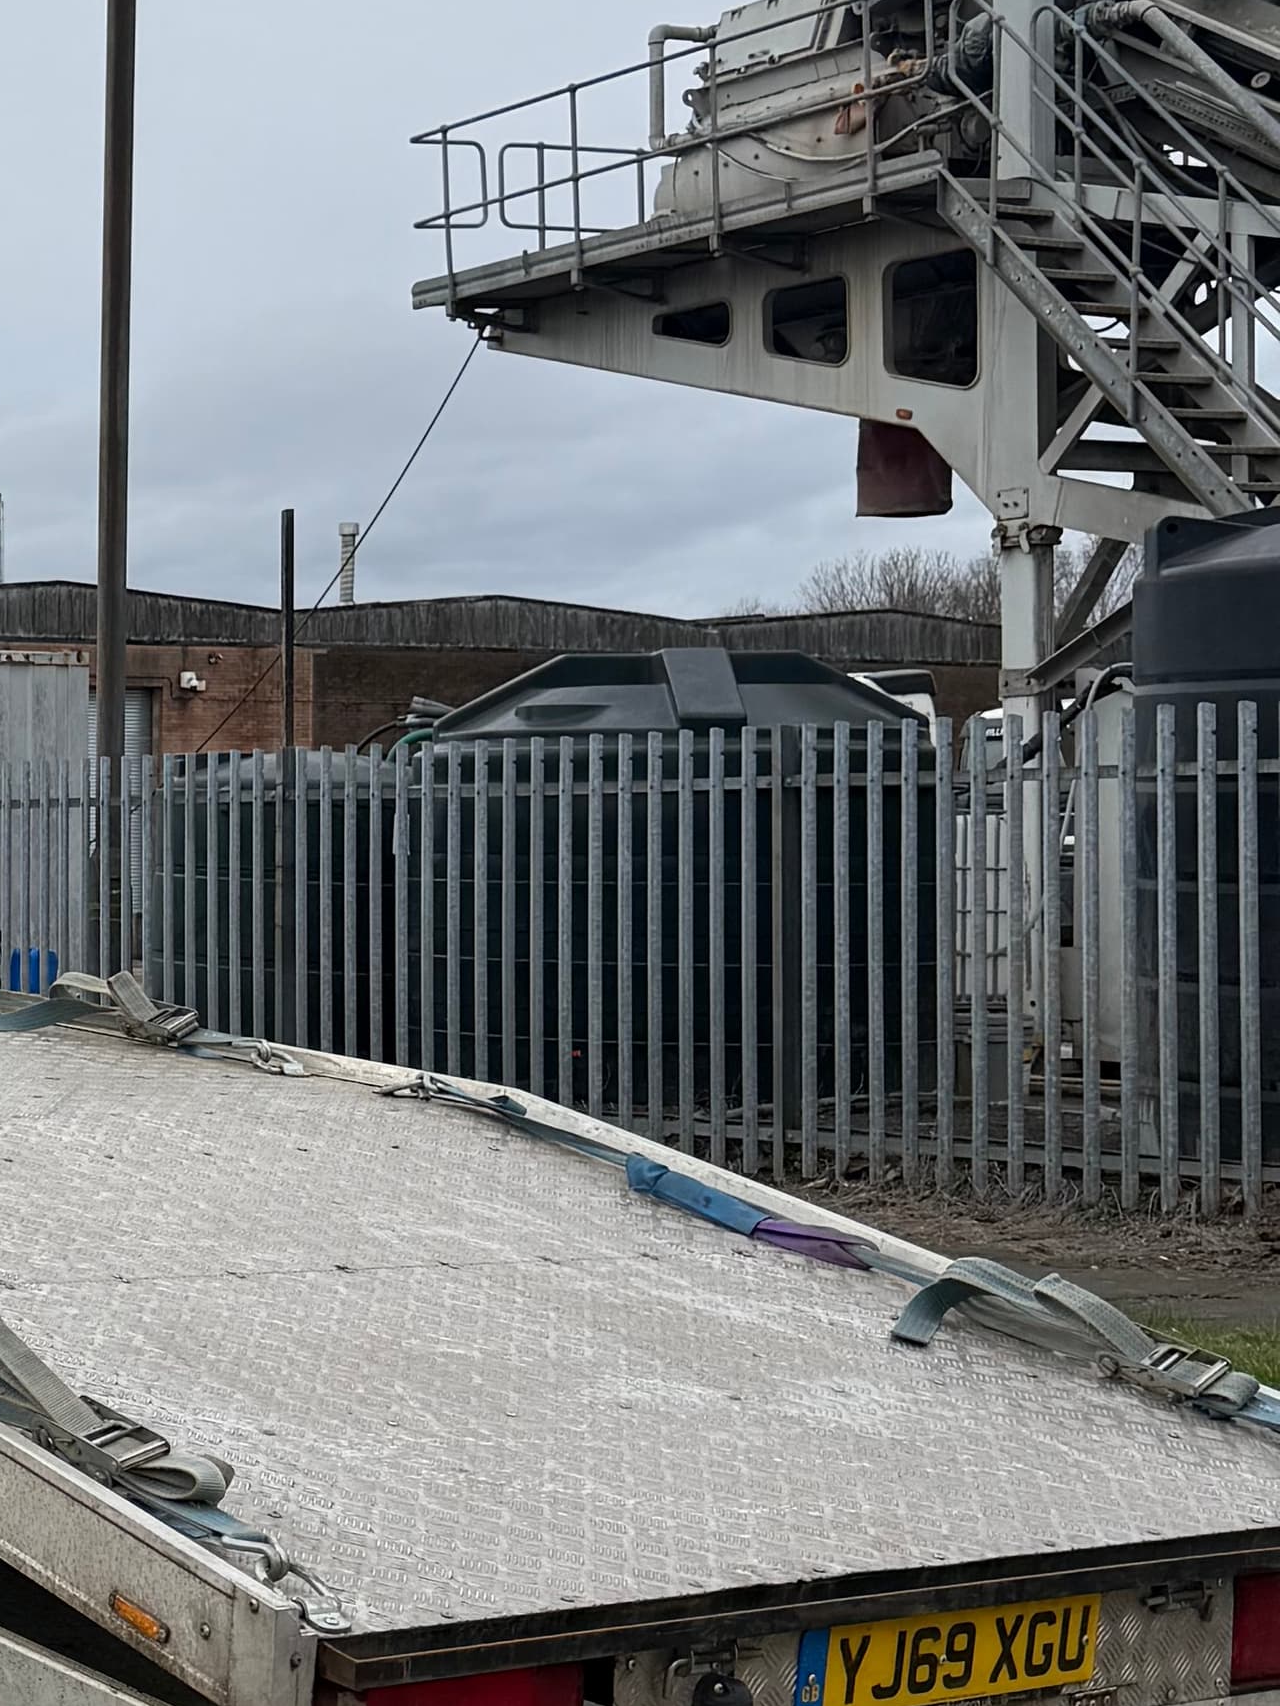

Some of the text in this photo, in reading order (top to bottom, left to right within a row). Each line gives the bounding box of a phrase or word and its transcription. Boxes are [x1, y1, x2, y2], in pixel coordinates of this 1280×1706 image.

[839, 1605, 1092, 1705] YJ69 XGU
[801, 1684, 820, 1703] GB
